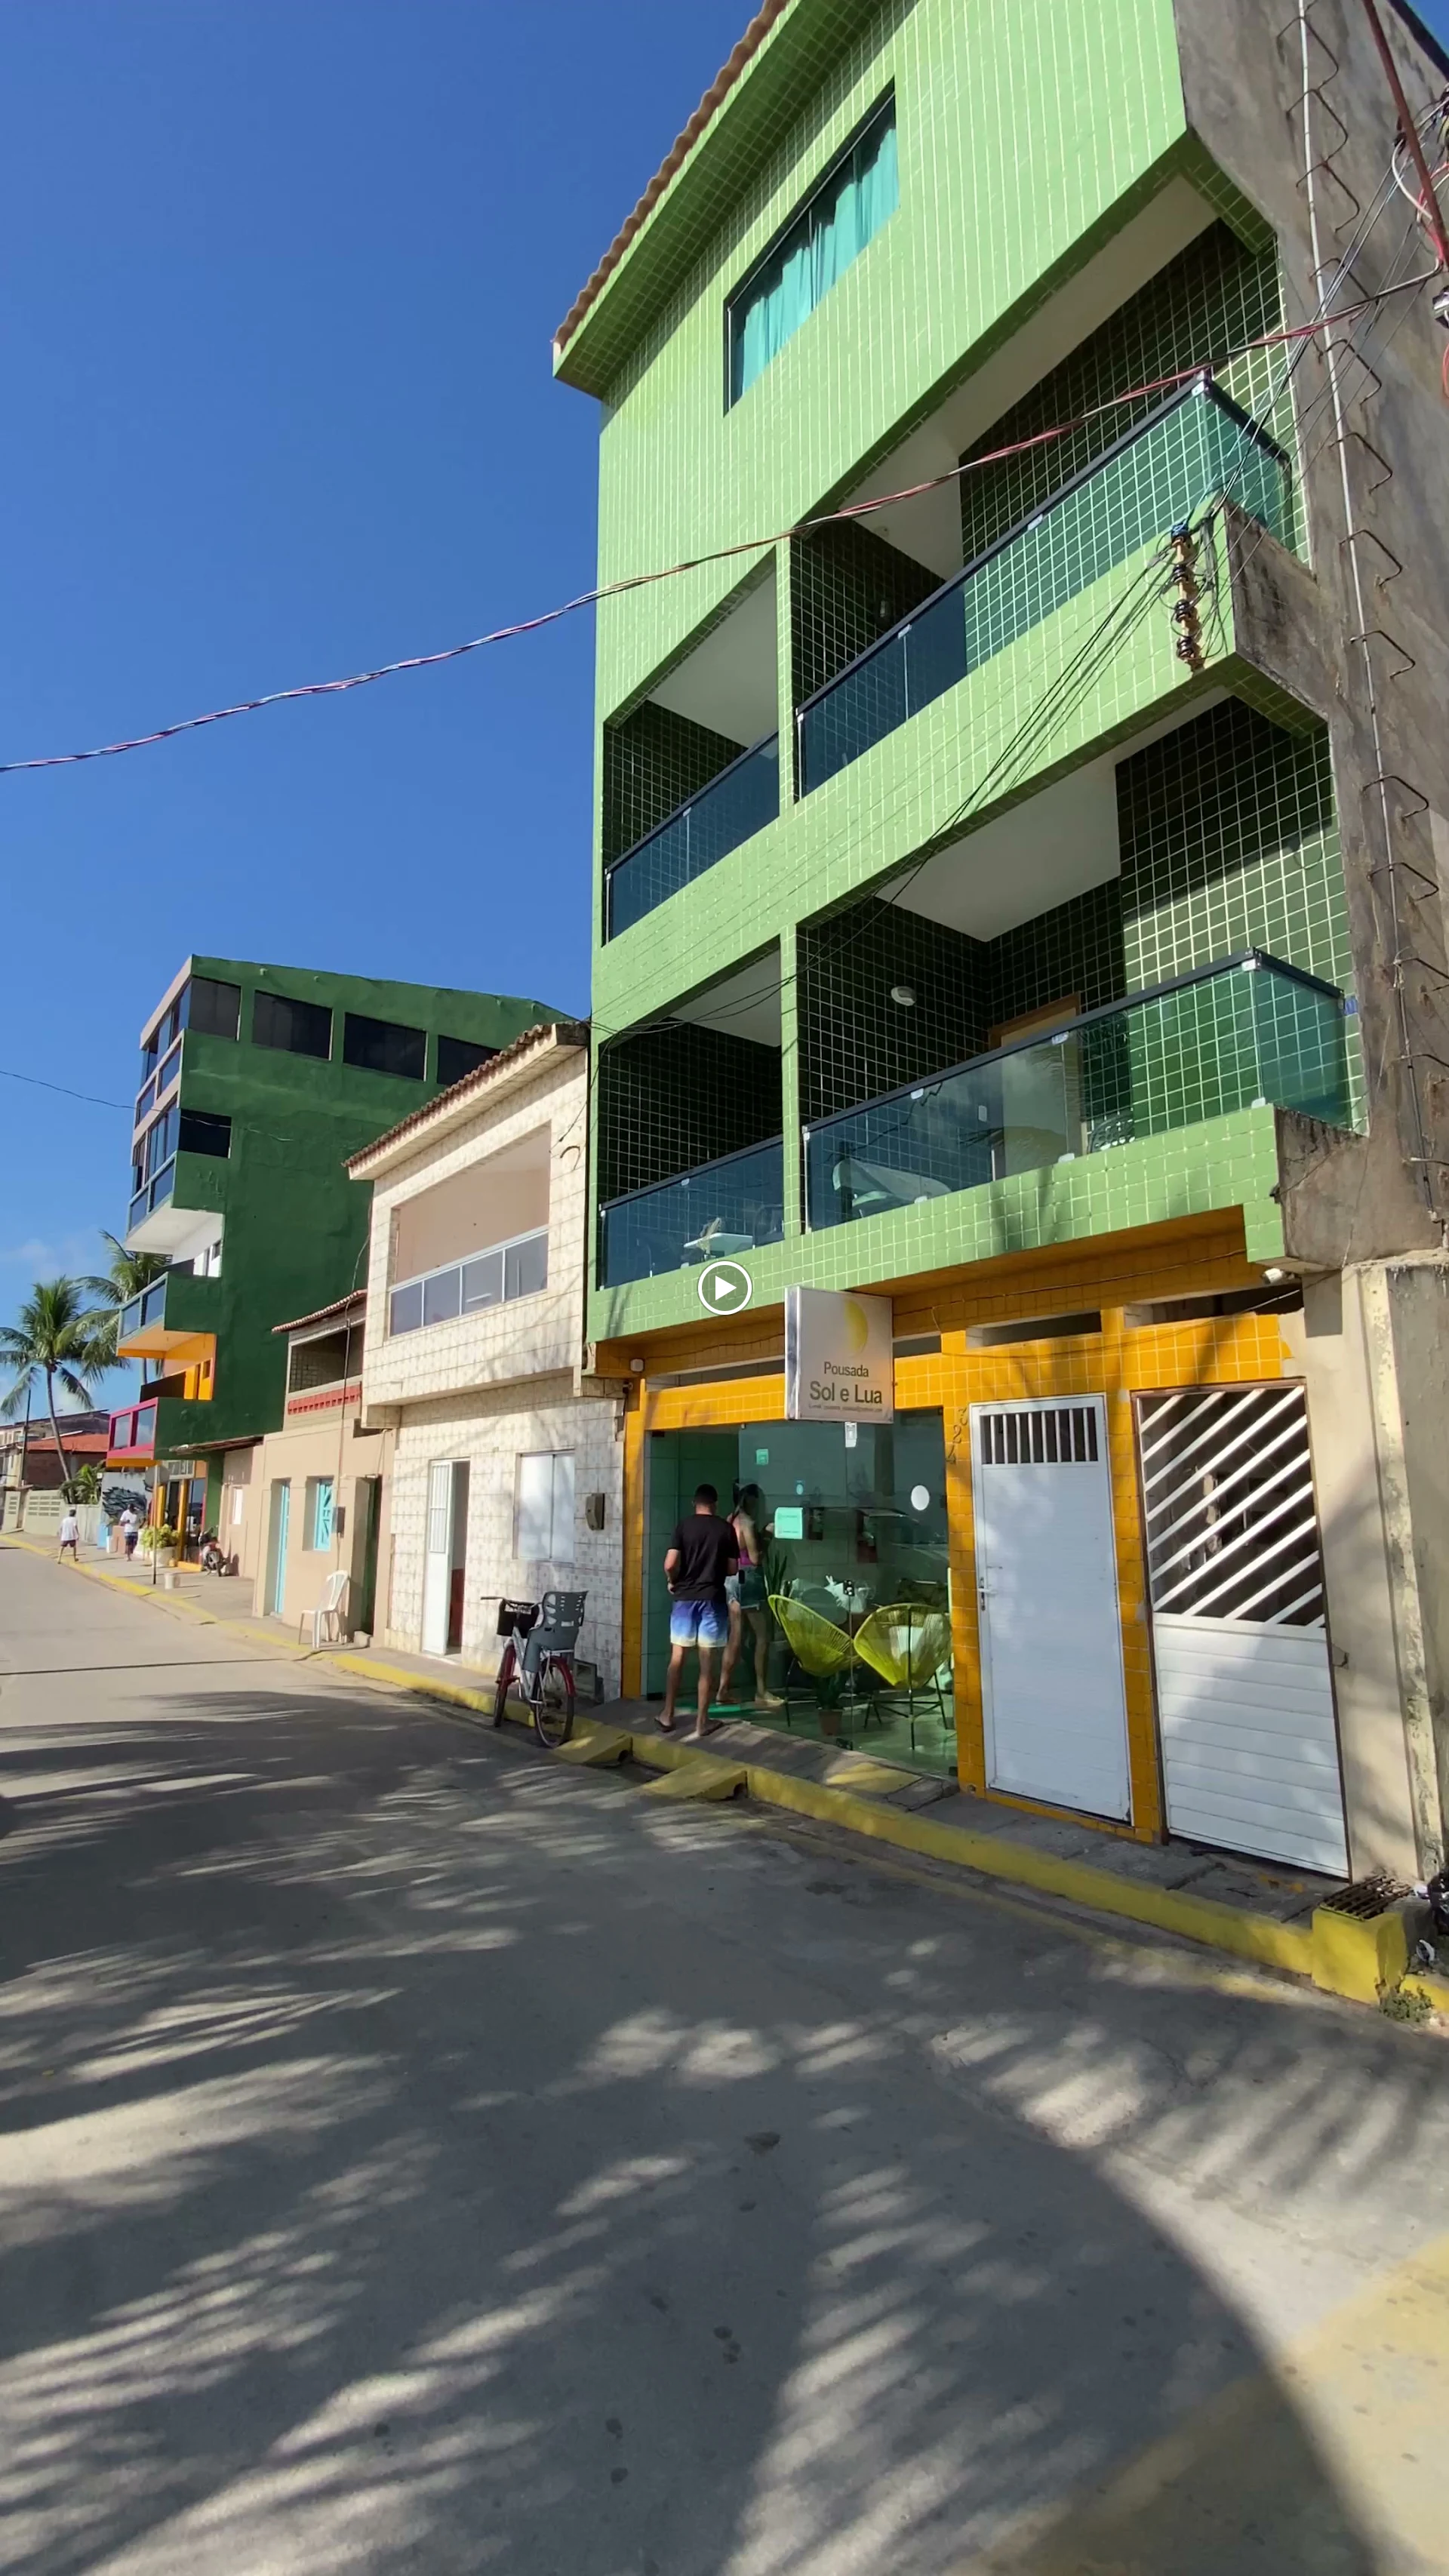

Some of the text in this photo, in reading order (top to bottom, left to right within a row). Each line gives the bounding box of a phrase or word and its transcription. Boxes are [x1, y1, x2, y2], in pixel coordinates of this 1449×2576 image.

[824, 1362, 869, 1377] Pousada
[810, 1380, 882, 1404] Sol e Lua
